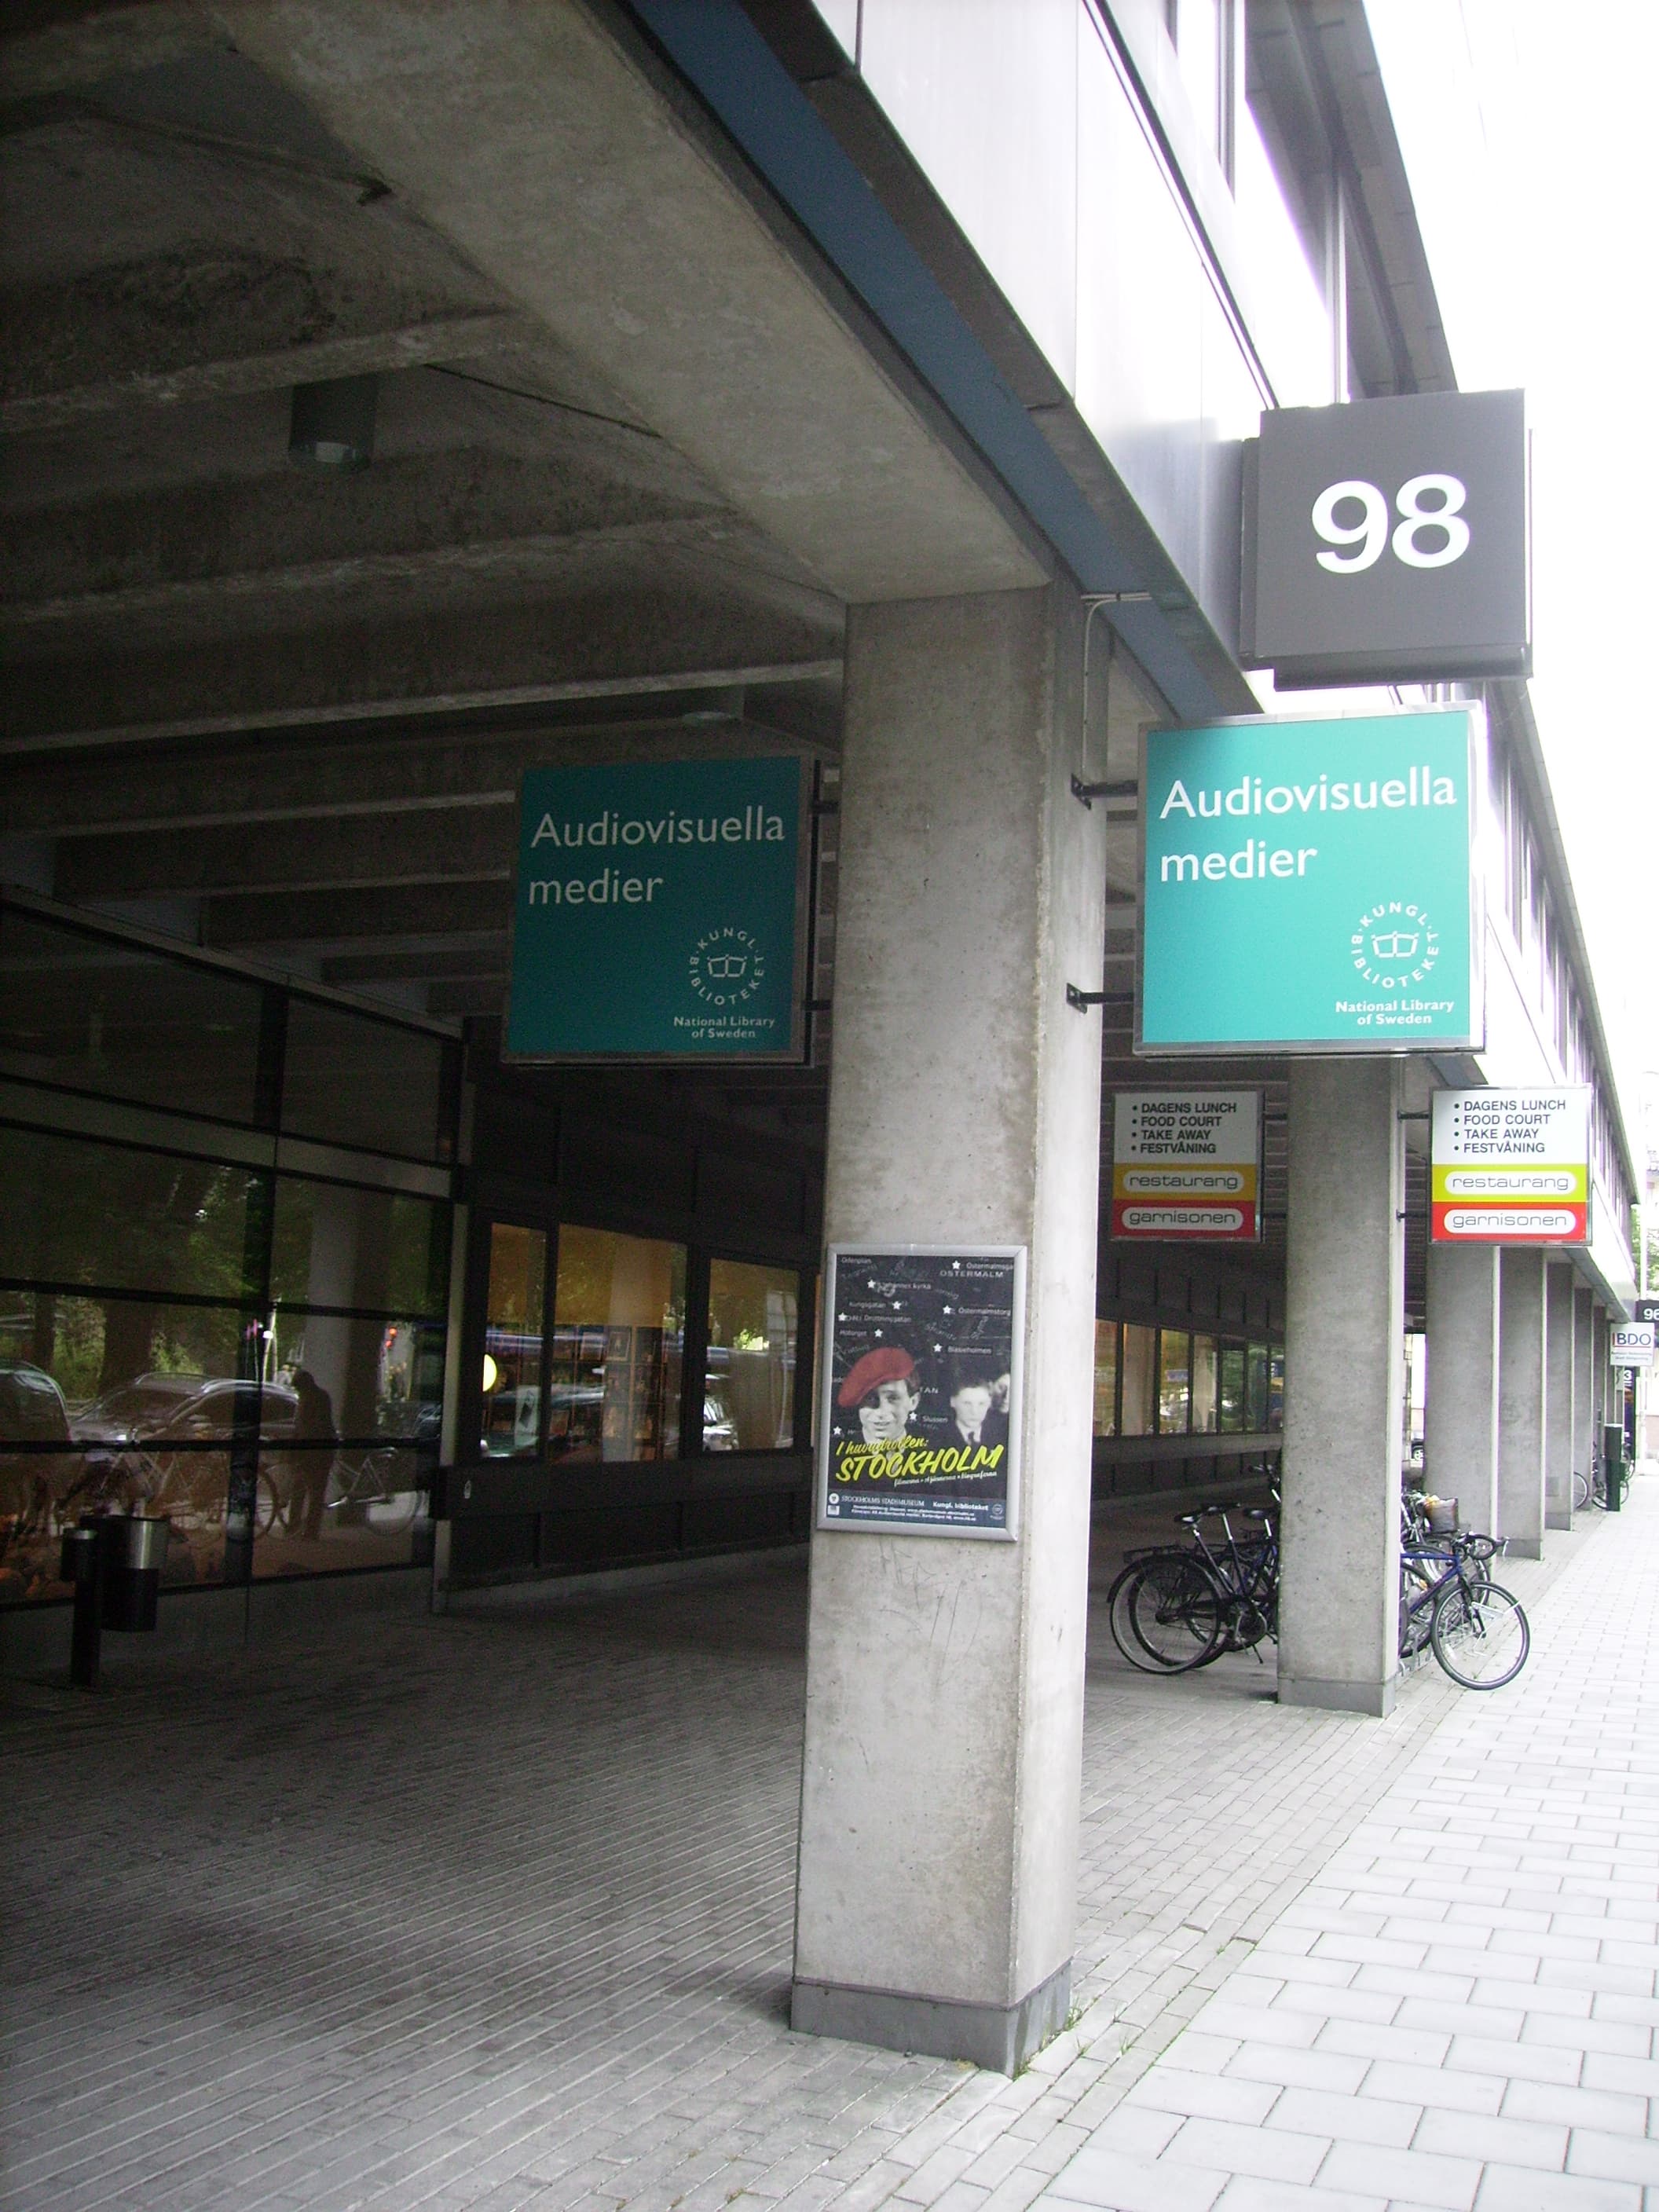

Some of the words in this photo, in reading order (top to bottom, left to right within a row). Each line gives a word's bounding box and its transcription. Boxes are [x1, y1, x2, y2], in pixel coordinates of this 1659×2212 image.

[1312, 474, 1470, 573] 98
[1159, 766, 1457, 819] Audiovisuella
[530, 805, 786, 848] Audiovisuella
[1161, 839, 1318, 882] medier
[529, 868, 664, 905] medier
[1351, 932, 1440, 988] BIBLIOTEKET
[689, 954, 765, 1005] BIBLIOTEKET
[1335, 1000, 1397, 1013] National
[1401, 1000, 1454, 1013] Library
[674, 1016, 727, 1027] National
[731, 1016, 775, 1028] Library
[1357, 1014, 1372, 1025] of
[1376, 1013, 1432, 1025] Sweden
[691, 1028, 705, 1038] of
[708, 1028, 756, 1038] Sweden
[1141, 1103, 1192, 1113] DAGENS
[1195, 1102, 1237, 1113] LUNCH
[1463, 1101, 1517, 1111] DAGENS
[1522, 1100, 1566, 1110] LUNCH
[1141, 1116, 1175, 1126] FOOD
[1179, 1116, 1221, 1126] COURT
[1463, 1115, 1500, 1125] FOOD
[1505, 1115, 1551, 1125] COURT
[1141, 1130, 1172, 1140] TAKE
[1177, 1130, 1211, 1140] AWAY
[1464, 1129, 1498, 1139] TAKE
[1503, 1129, 1539, 1138] AWAY
[1141, 1141, 1216, 1153] FESTVÅNING
[1463, 1141, 1545, 1153] FESTVÅNING
[1130, 1177, 1238, 1189] restaurang
[1452, 1176, 1569, 1190] restaurang
[1129, 1210, 1236, 1225] garnisonen
[1452, 1214, 1567, 1227] garnisonen
[1643, 1308, 1659, 1320] 96
[1617, 1333, 1651, 1345] BDO
[836, 1441, 845, 1456] I
[846, 1435, 929, 1455] huvudrollen:
[835, 1445, 1005, 1482] STOCKHOLM
[841, 1495, 881, 1503] STOCKHOLMS
[882, 1497, 925, 1507] STADSMUSEUM
[954, 1502, 989, 1511] biblioteket
